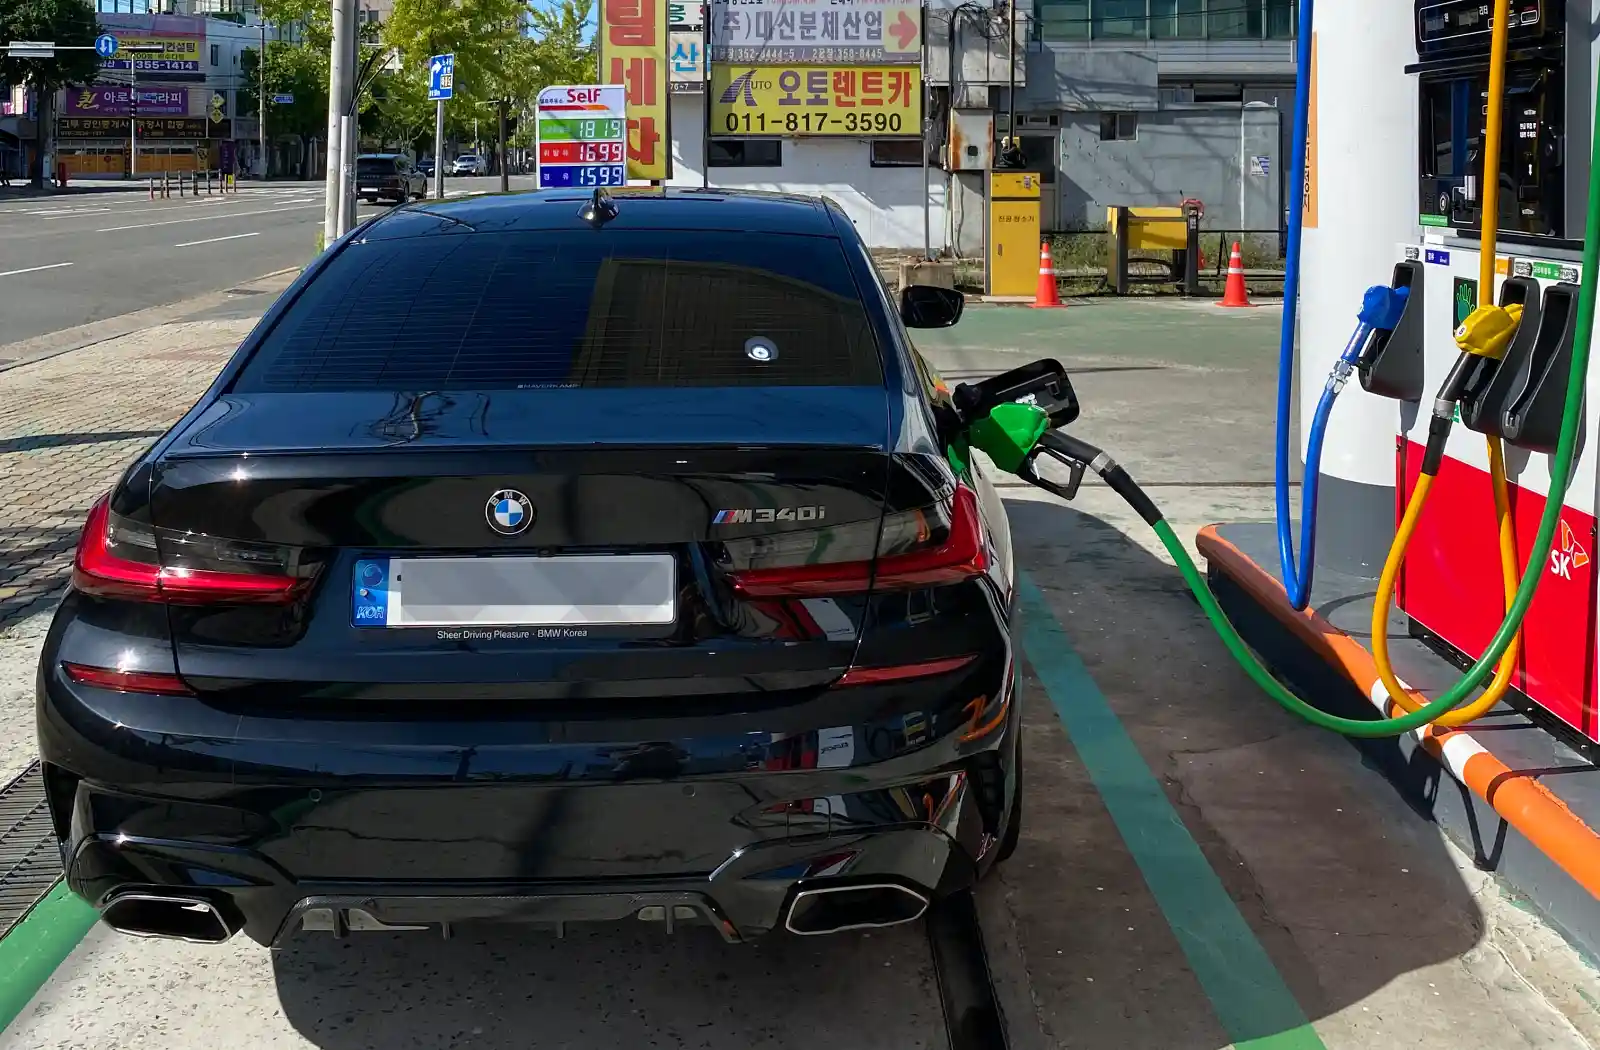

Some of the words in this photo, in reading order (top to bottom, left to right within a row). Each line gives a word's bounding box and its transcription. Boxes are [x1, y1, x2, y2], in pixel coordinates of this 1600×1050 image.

[713, 11, 882, 40] (주)대신분체산업
[136, 61, 193, 69] 355-1414
[671, 43, 700, 72] 산
[567, 88, 602, 103] Self
[778, 70, 912, 107] 오토렌트카
[580, 121, 620, 138] 1819
[726, 112, 901, 132] 011-817-3590
[580, 143, 622, 162] 1699
[580, 166, 622, 185] 1599
[491, 491, 529, 506] BMW
[720, 505, 826, 523] M340i
[1551, 549, 1571, 580] SK
[357, 605, 384, 619] KOR
[437, 630, 461, 640] Sheer
[463, 630, 492, 640] Driving
[494, 629, 529, 639] Pleasure
[537, 629, 561, 638] BMW
[563, 629, 588, 638] Korea
